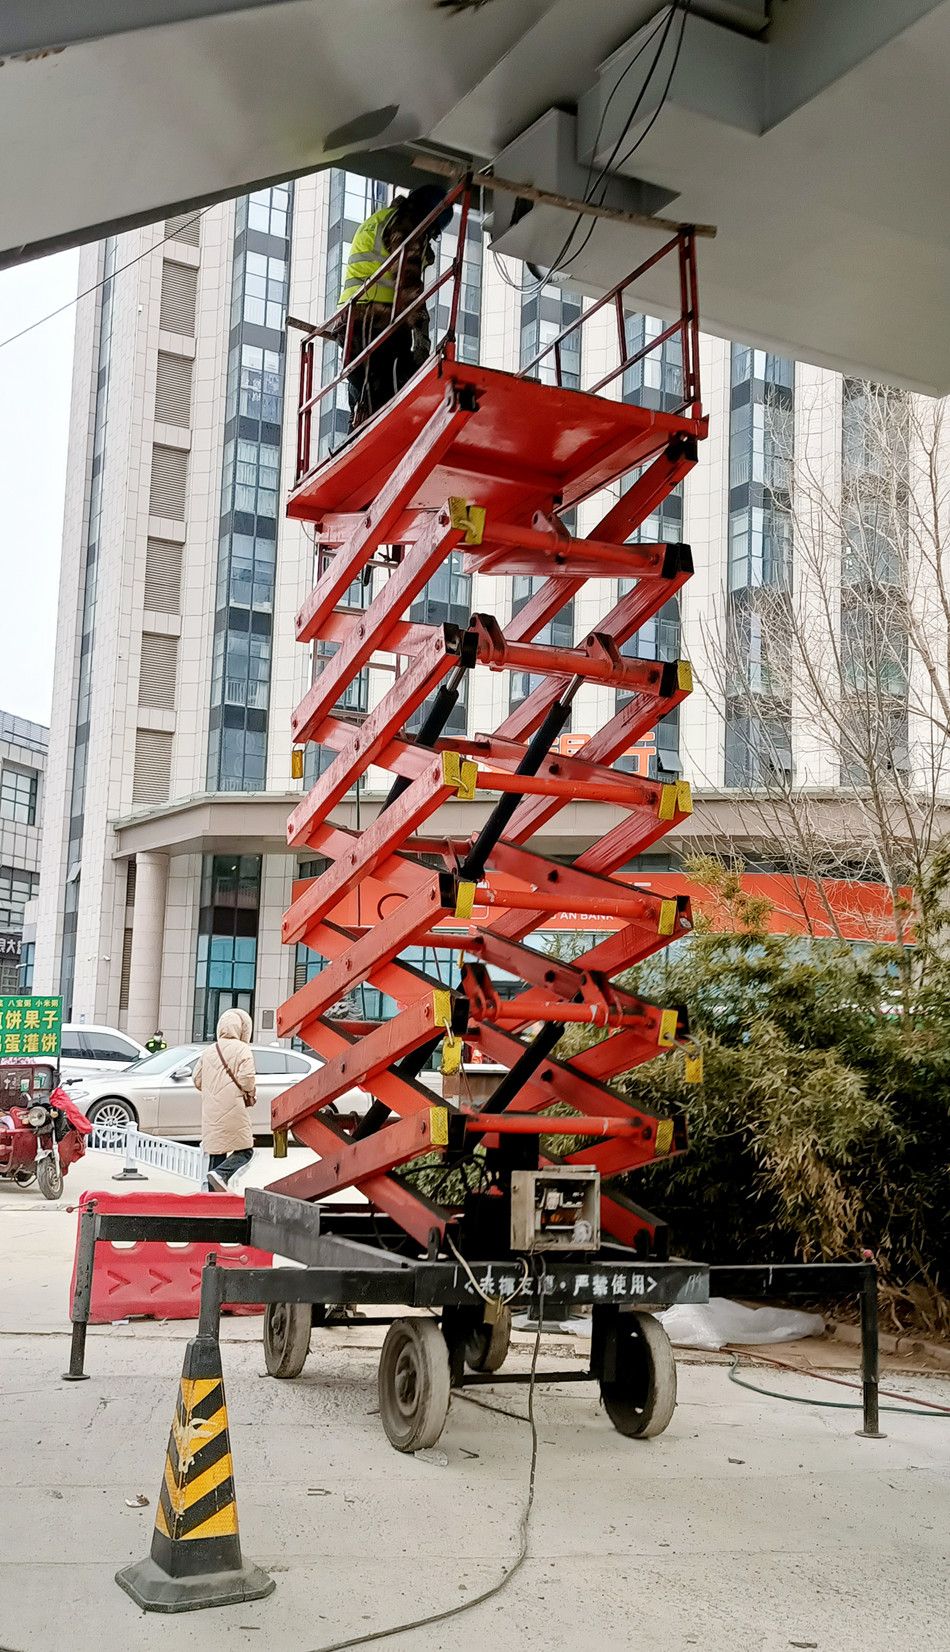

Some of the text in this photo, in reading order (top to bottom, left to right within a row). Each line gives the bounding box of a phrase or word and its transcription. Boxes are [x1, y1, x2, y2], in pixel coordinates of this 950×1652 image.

[560, 912, 577, 920] AN
[0, 1009, 59, 1030] 饼果子
[0, 1032, 58, 1053] 蛋灌饼
